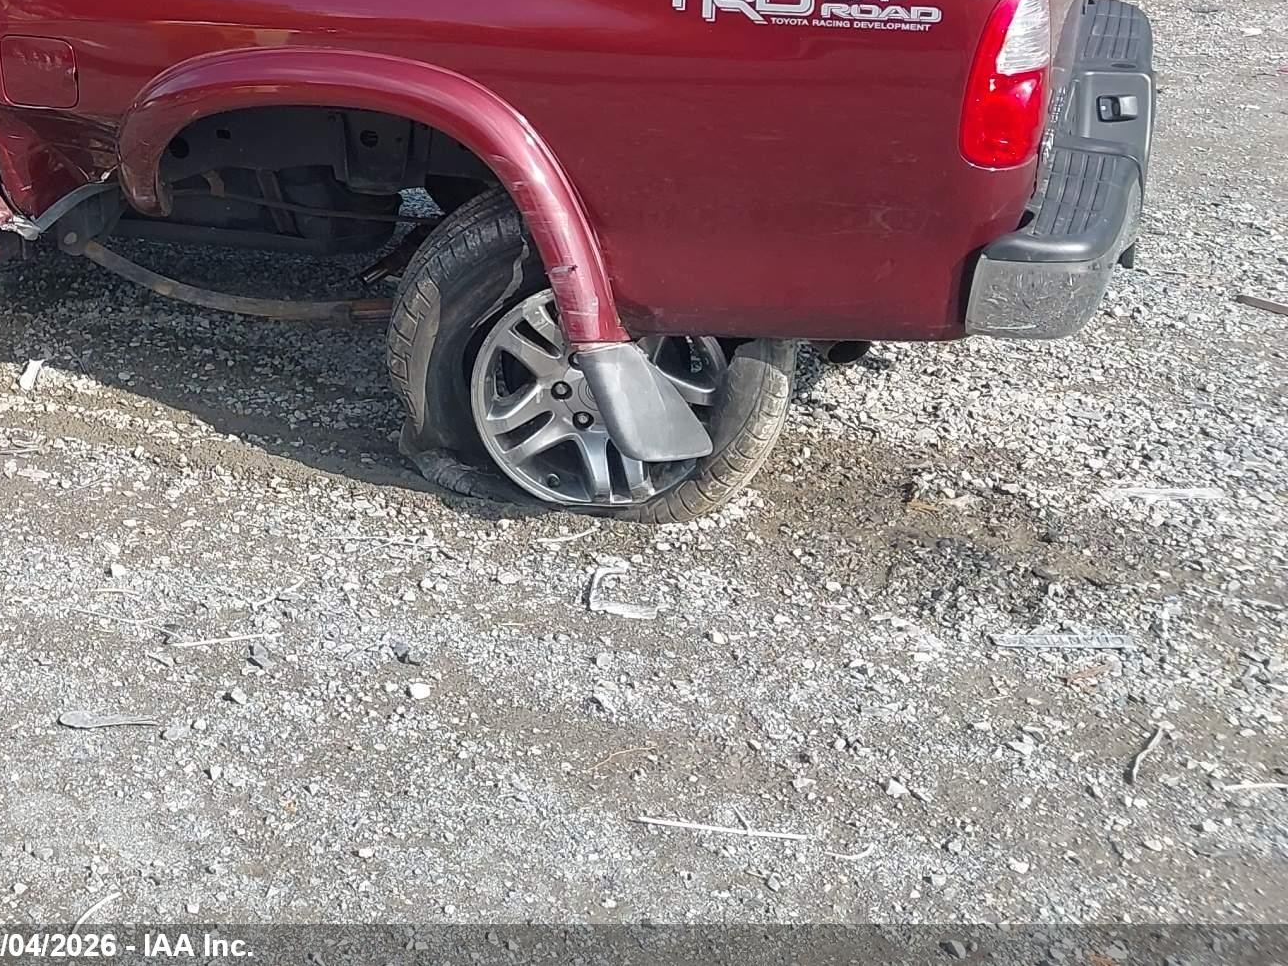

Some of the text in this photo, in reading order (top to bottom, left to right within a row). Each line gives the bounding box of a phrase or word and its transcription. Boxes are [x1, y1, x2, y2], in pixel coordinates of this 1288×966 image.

[821, 3, 943, 23] ROAD
[770, 17, 932, 32] TOYOTA RACING DEVELOPMENT
